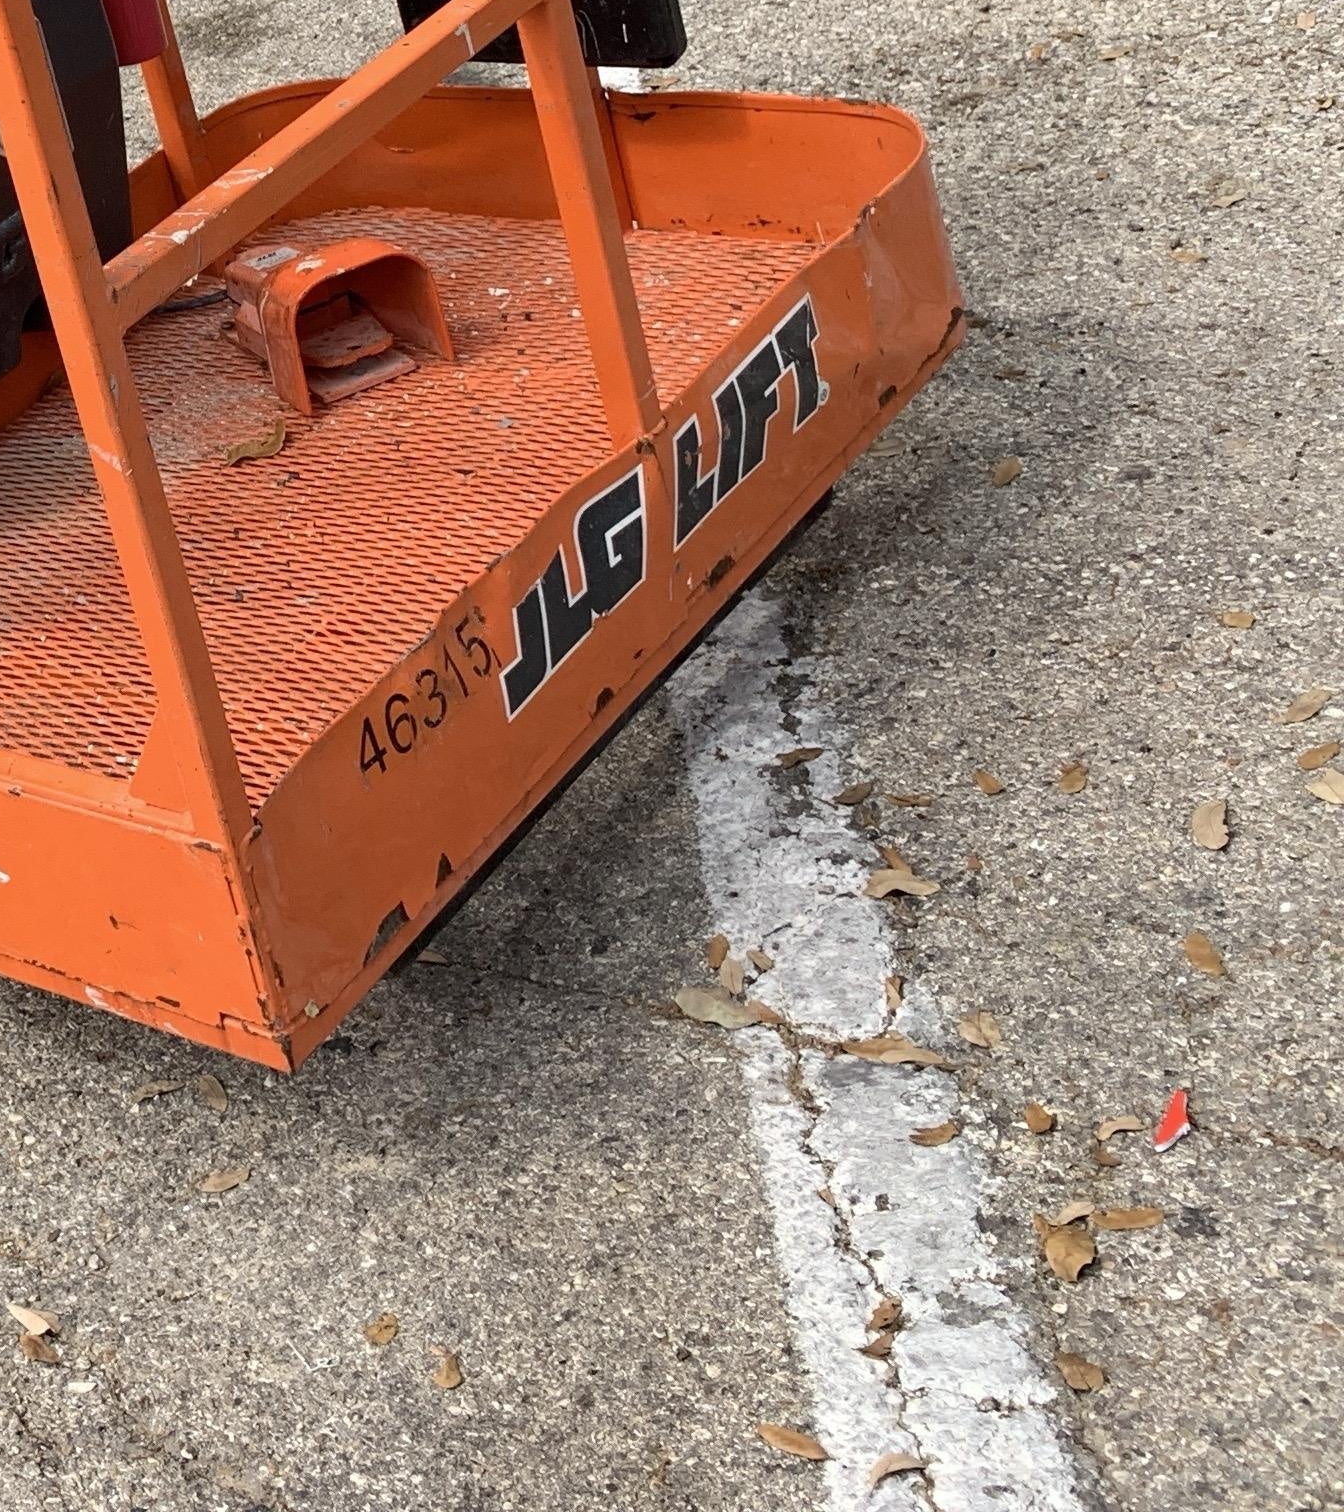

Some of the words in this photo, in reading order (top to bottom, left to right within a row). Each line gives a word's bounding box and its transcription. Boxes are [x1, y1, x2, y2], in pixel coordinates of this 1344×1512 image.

[499, 465, 647, 723] JLG
[673, 292, 820, 553] LIFT
[357, 610, 495, 776] 46315
